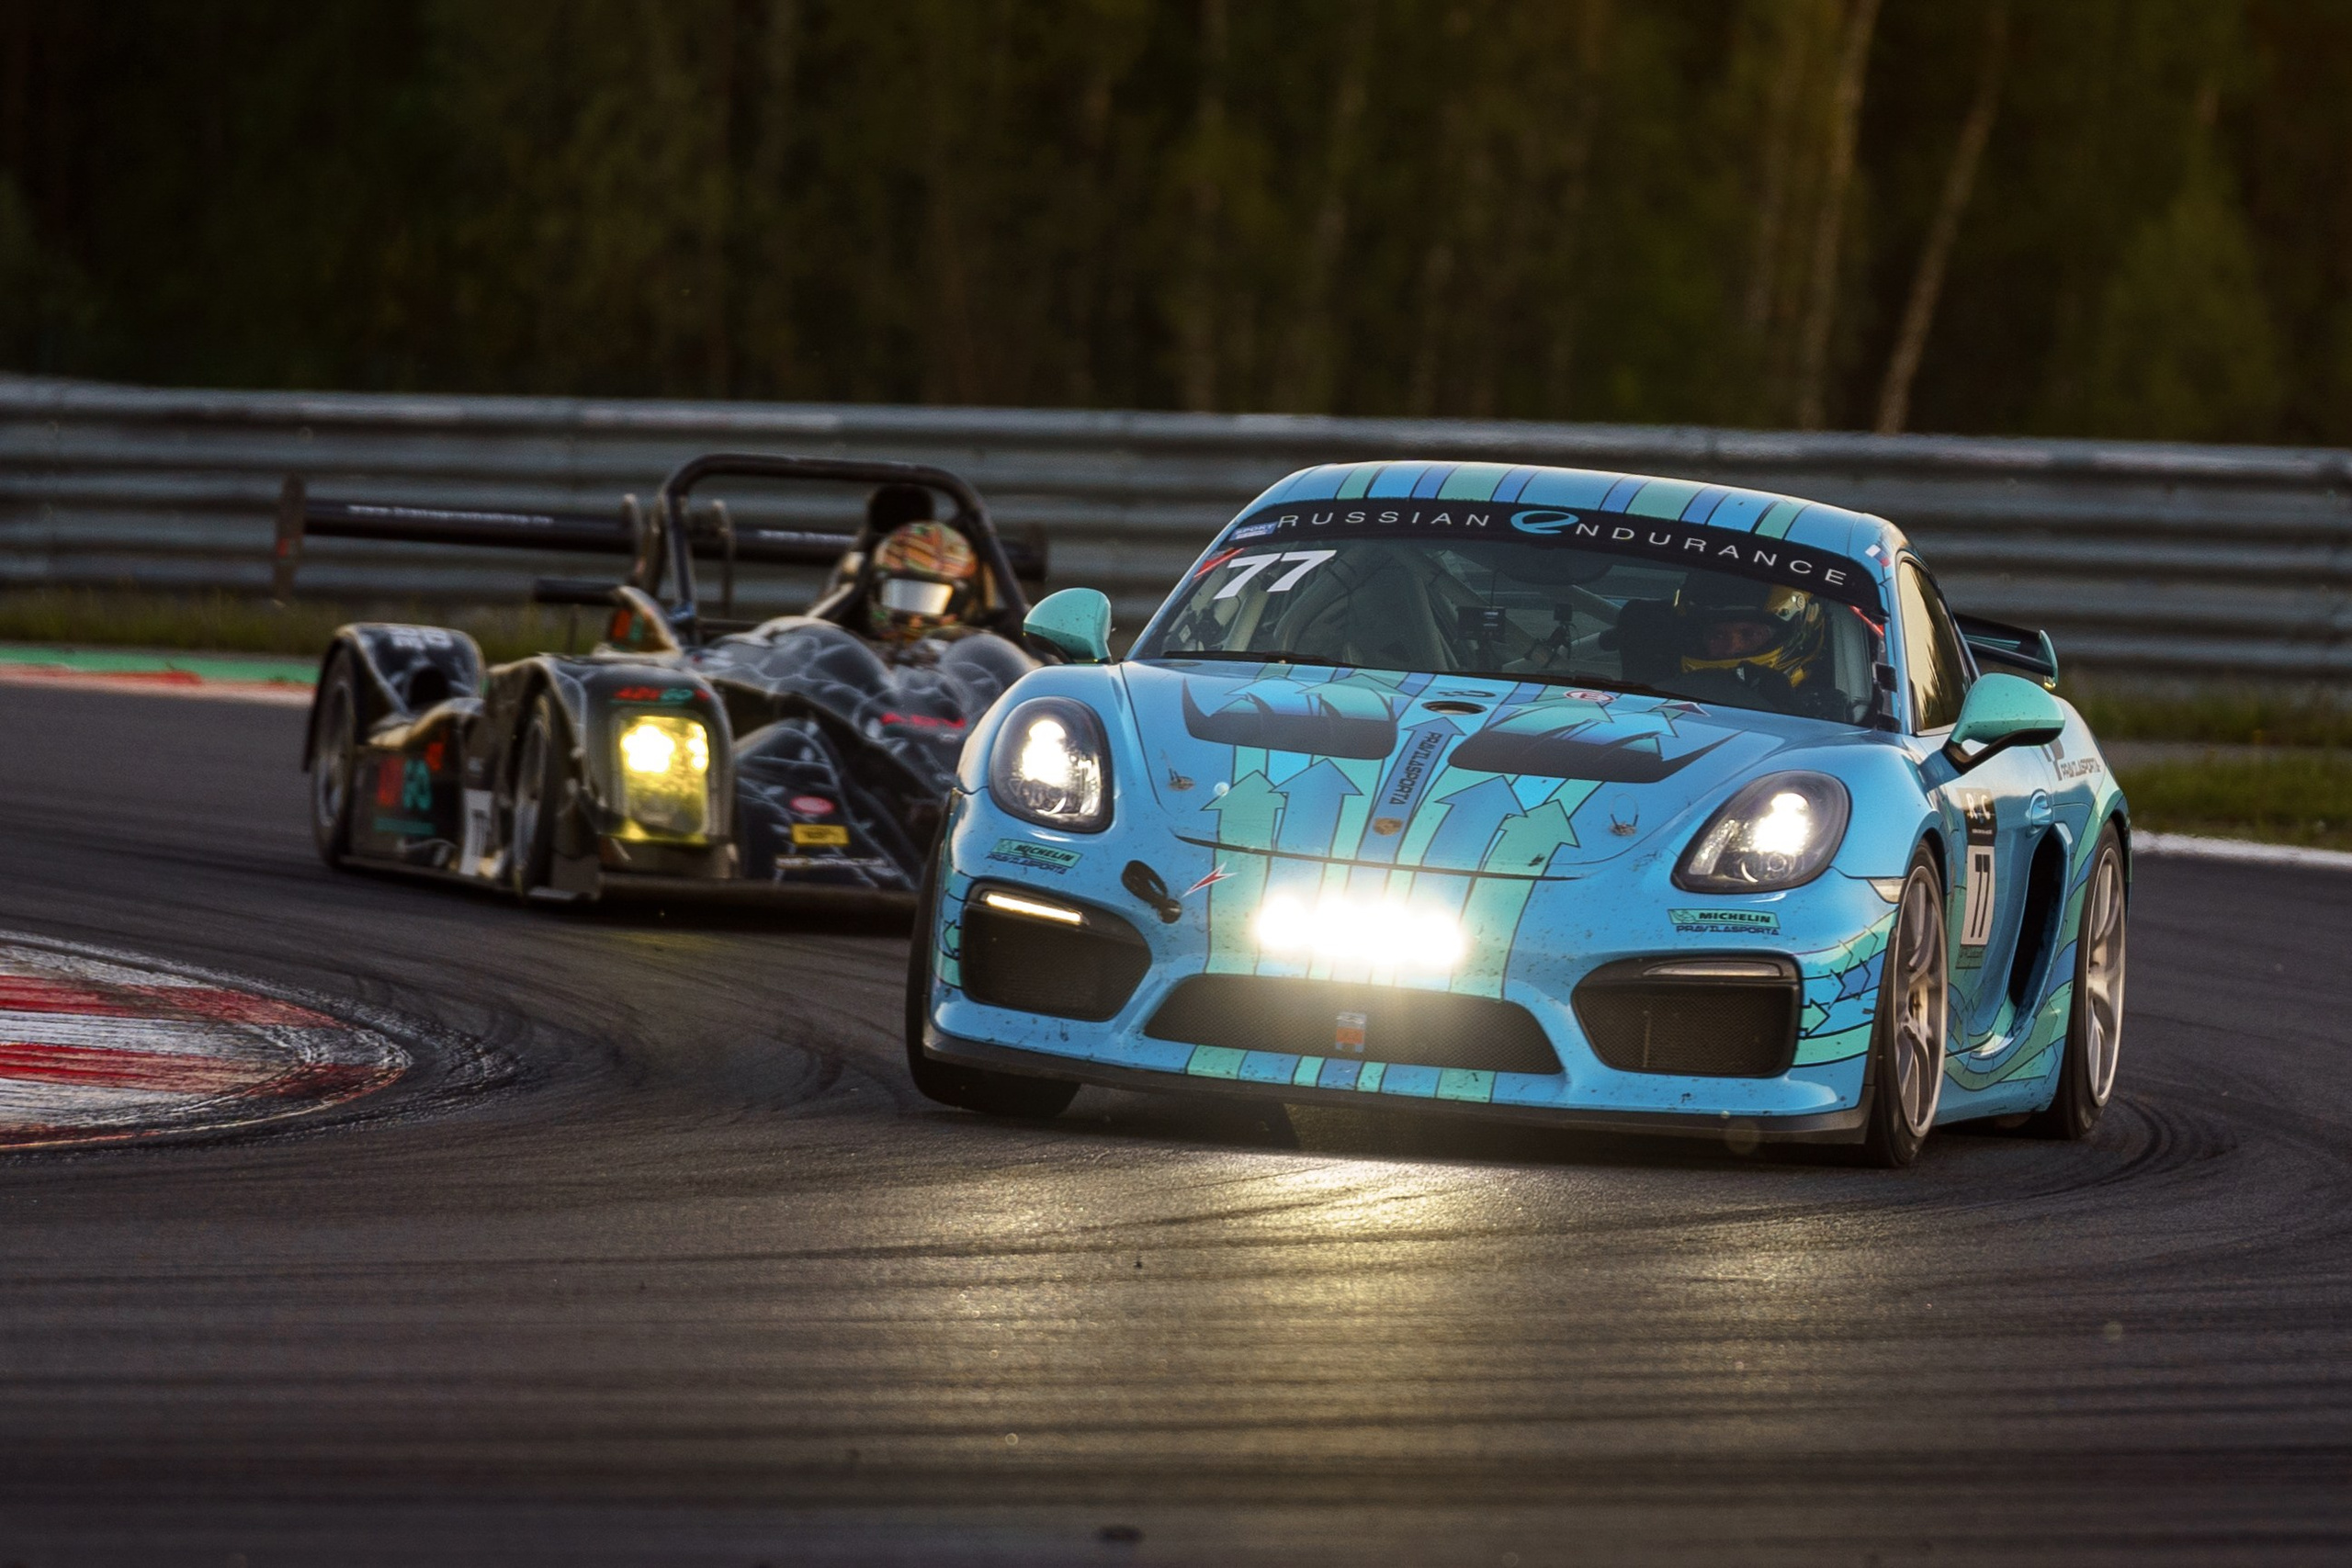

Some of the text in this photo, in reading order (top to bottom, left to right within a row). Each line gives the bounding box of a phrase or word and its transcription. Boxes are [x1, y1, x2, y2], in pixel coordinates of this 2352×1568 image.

[1277, 511, 1489, 528] RUSSIAN
[1213, 549, 1338, 600] 77
[1389, 731, 1443, 805] PRAVILASPORTA
[1014, 844, 1075, 862] MICHELIN
[1971, 853, 1991, 938] 77
[1699, 912, 1771, 923] MICHELIN
[1676, 925, 1780, 935] PRAVILASPORTA
